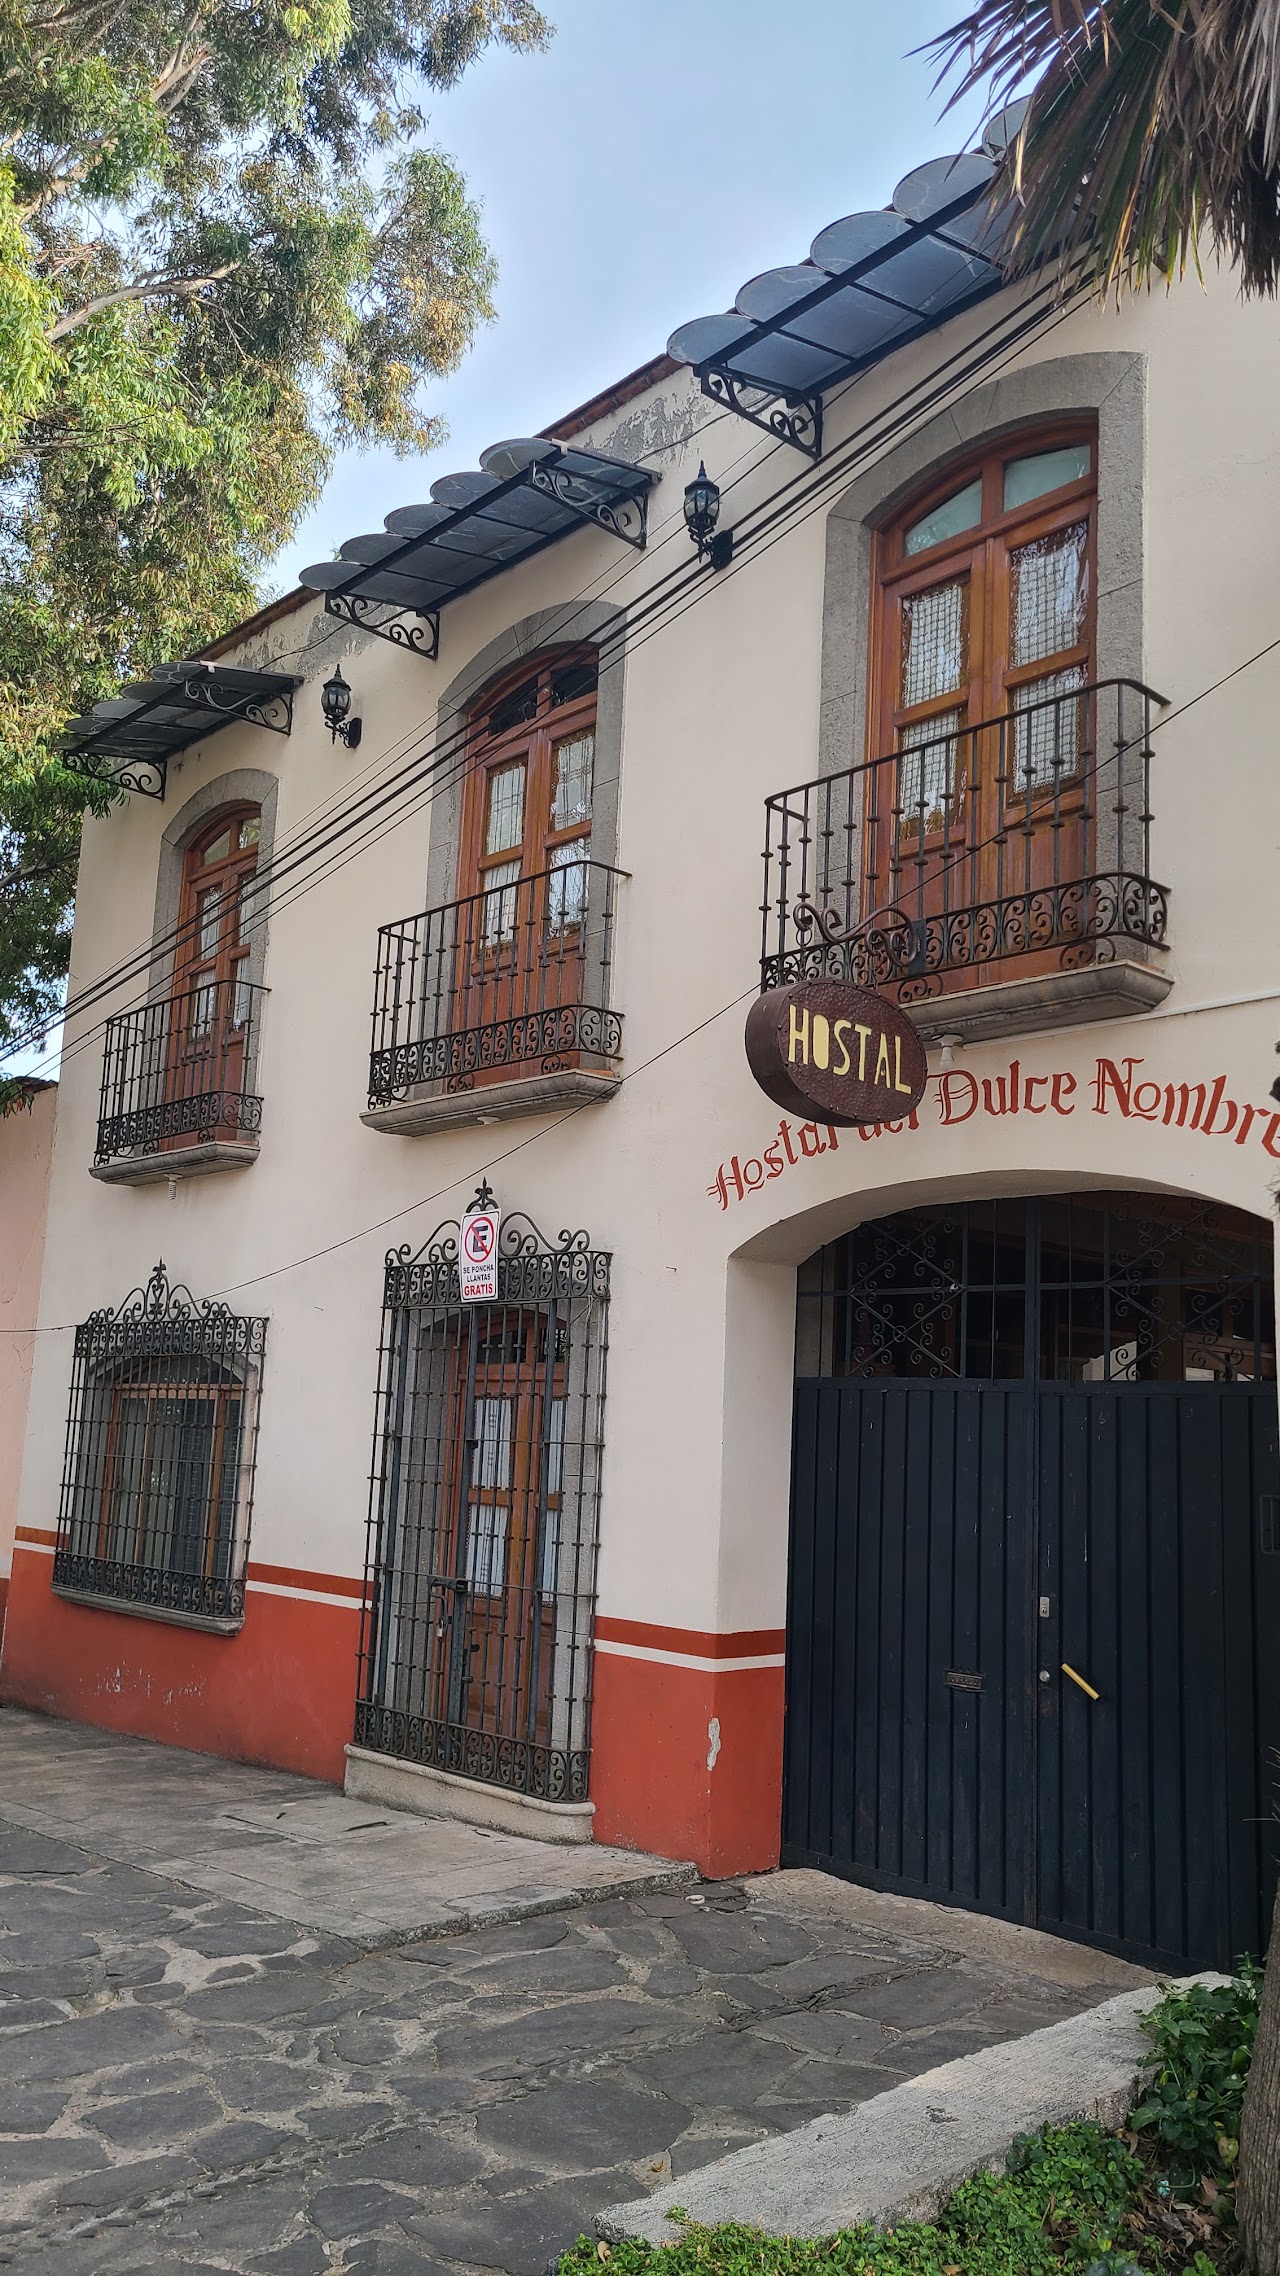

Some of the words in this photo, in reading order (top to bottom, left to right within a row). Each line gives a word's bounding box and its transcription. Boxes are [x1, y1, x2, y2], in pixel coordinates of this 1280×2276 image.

[787, 1003, 913, 1095] HOSTAL
[926, 1060, 1077, 1126] Dulce
[463, 1266, 471, 1275] SE
[472, 1264, 494, 1273] PONCHA
[466, 1273, 491, 1283] LLANTAS
[464, 1283, 493, 1296] GRATIS
